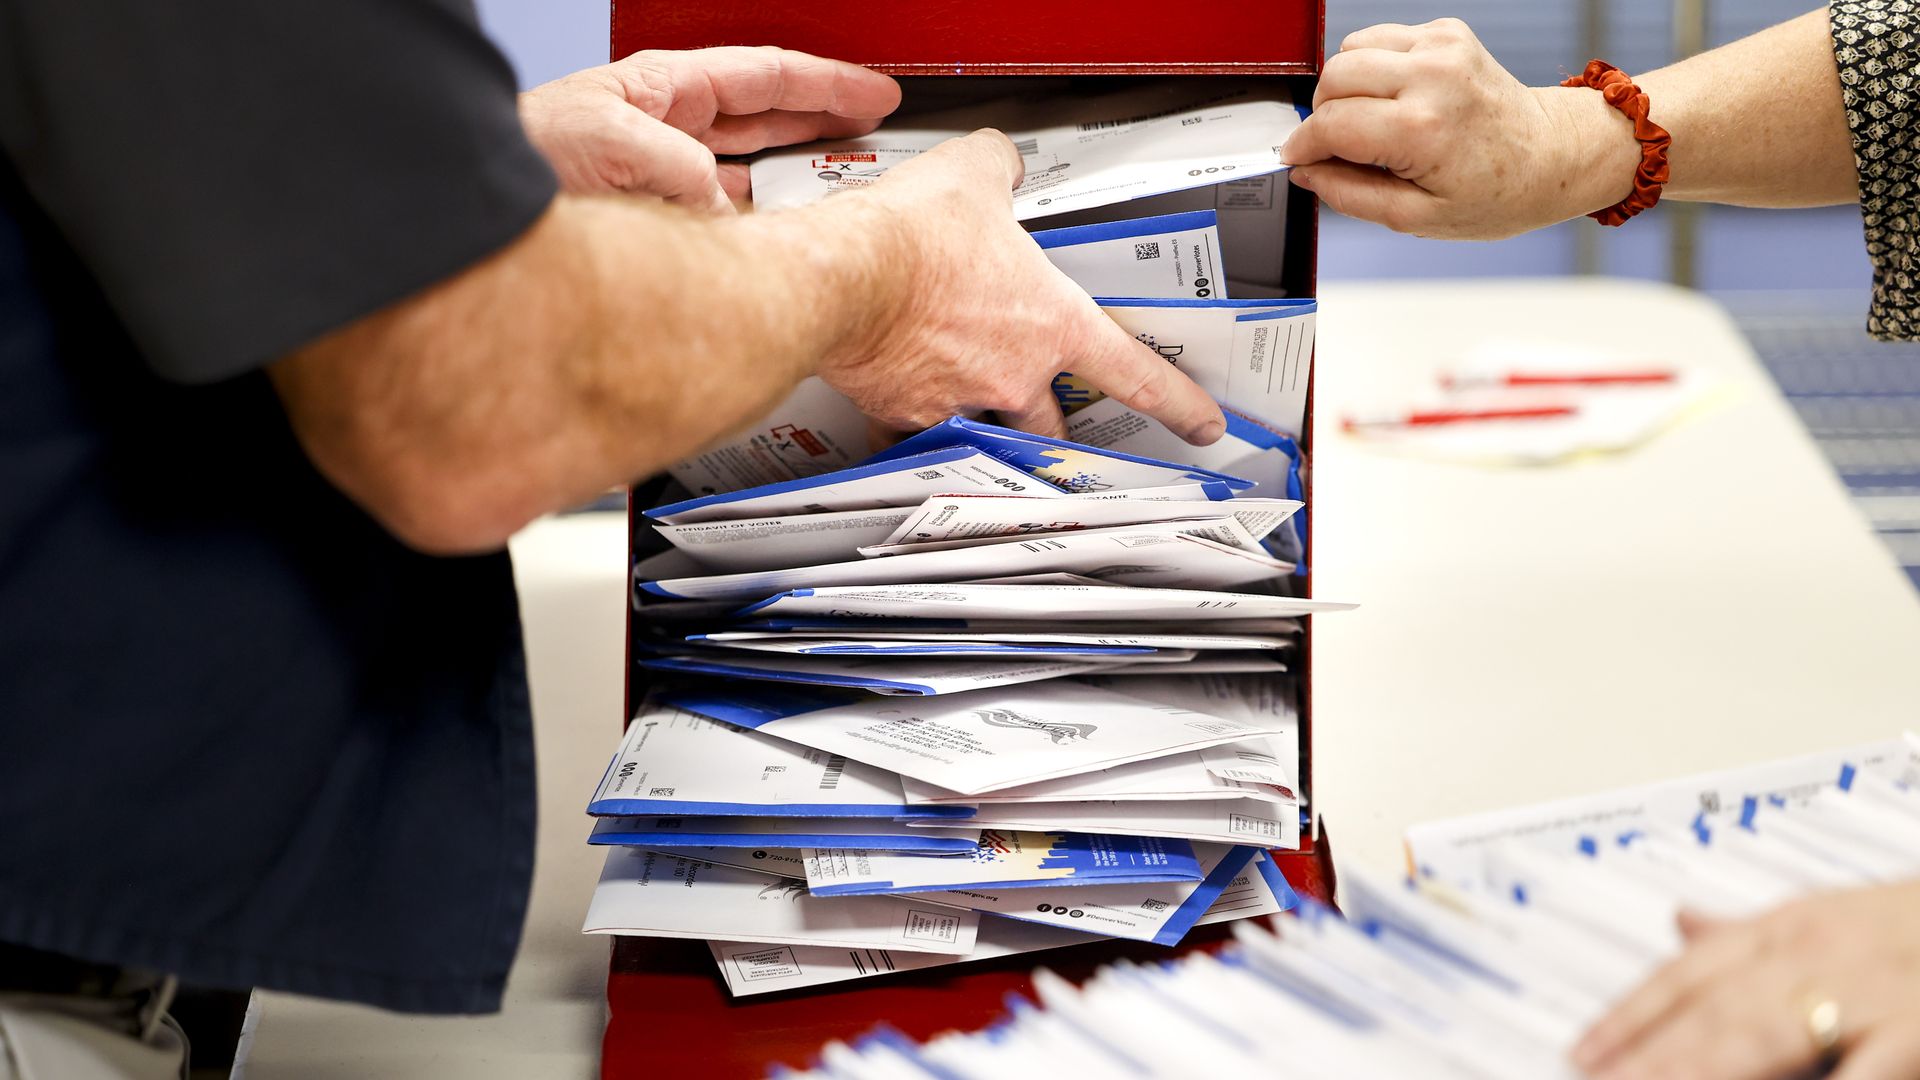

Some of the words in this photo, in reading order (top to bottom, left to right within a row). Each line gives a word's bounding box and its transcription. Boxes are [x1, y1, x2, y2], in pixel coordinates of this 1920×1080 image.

[1193, 244, 1204, 277] #DenverVotes
[675, 524, 727, 533] AFFIDAVIT
[1086, 913, 1136, 927] #DenverVotes
